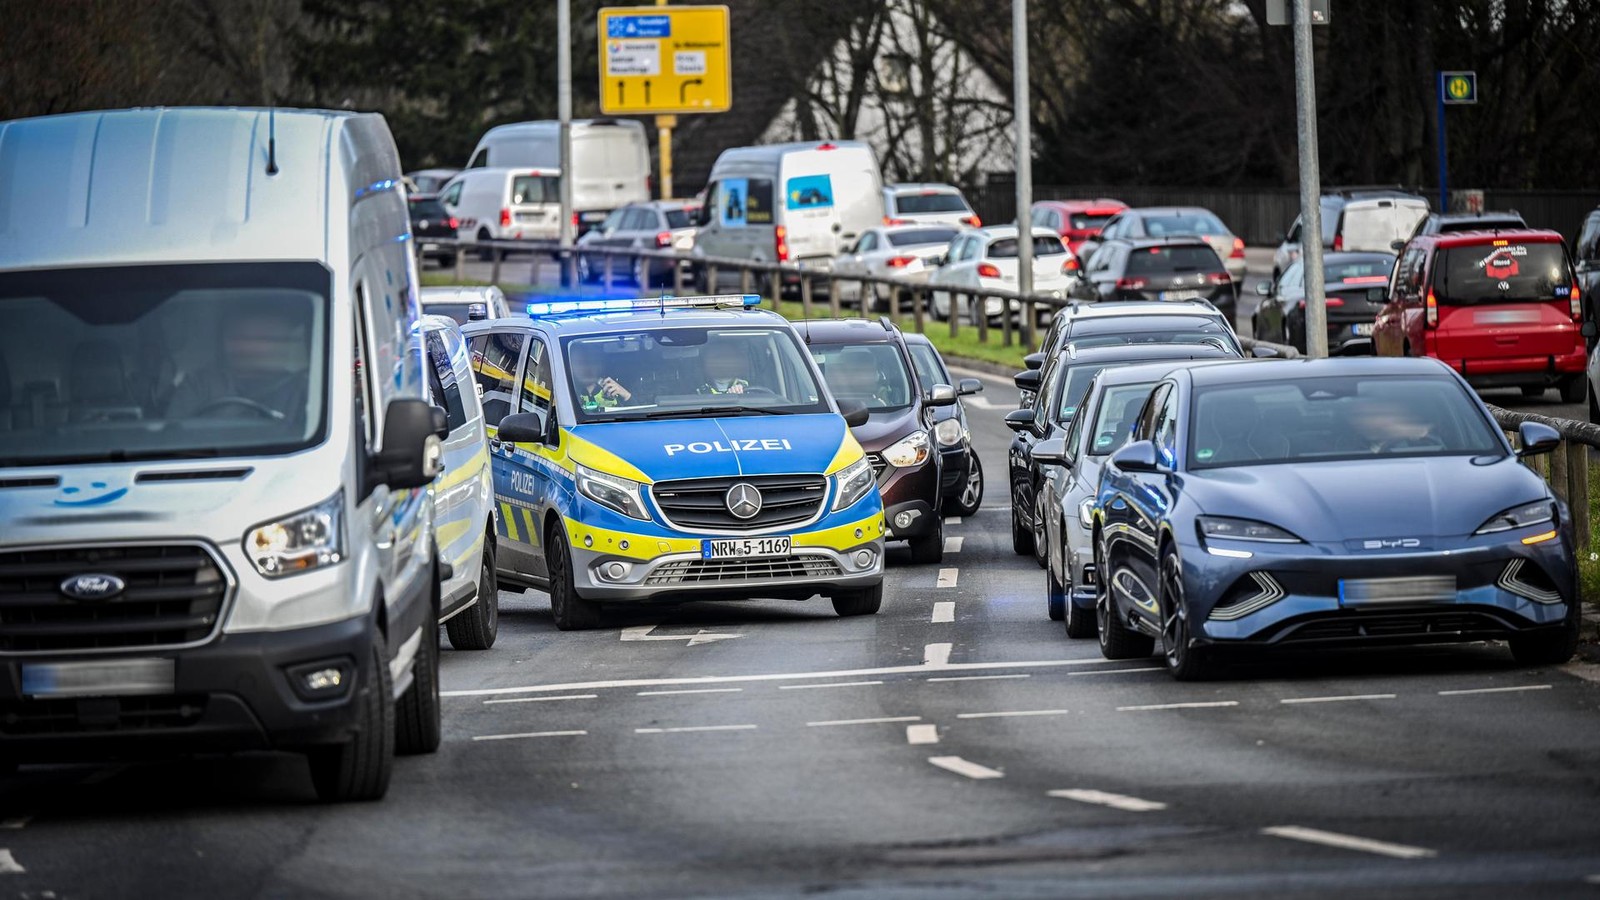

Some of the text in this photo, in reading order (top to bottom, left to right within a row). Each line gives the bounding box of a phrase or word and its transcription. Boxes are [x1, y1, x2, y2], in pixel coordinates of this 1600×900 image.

[664, 439, 792, 456] POLIZEI
[511, 470, 535, 496] POLIZEI
[711, 539, 789, 557] NRW 5-1169
[1364, 538, 1420, 549] BYD
[75, 577, 110, 593] Ford
